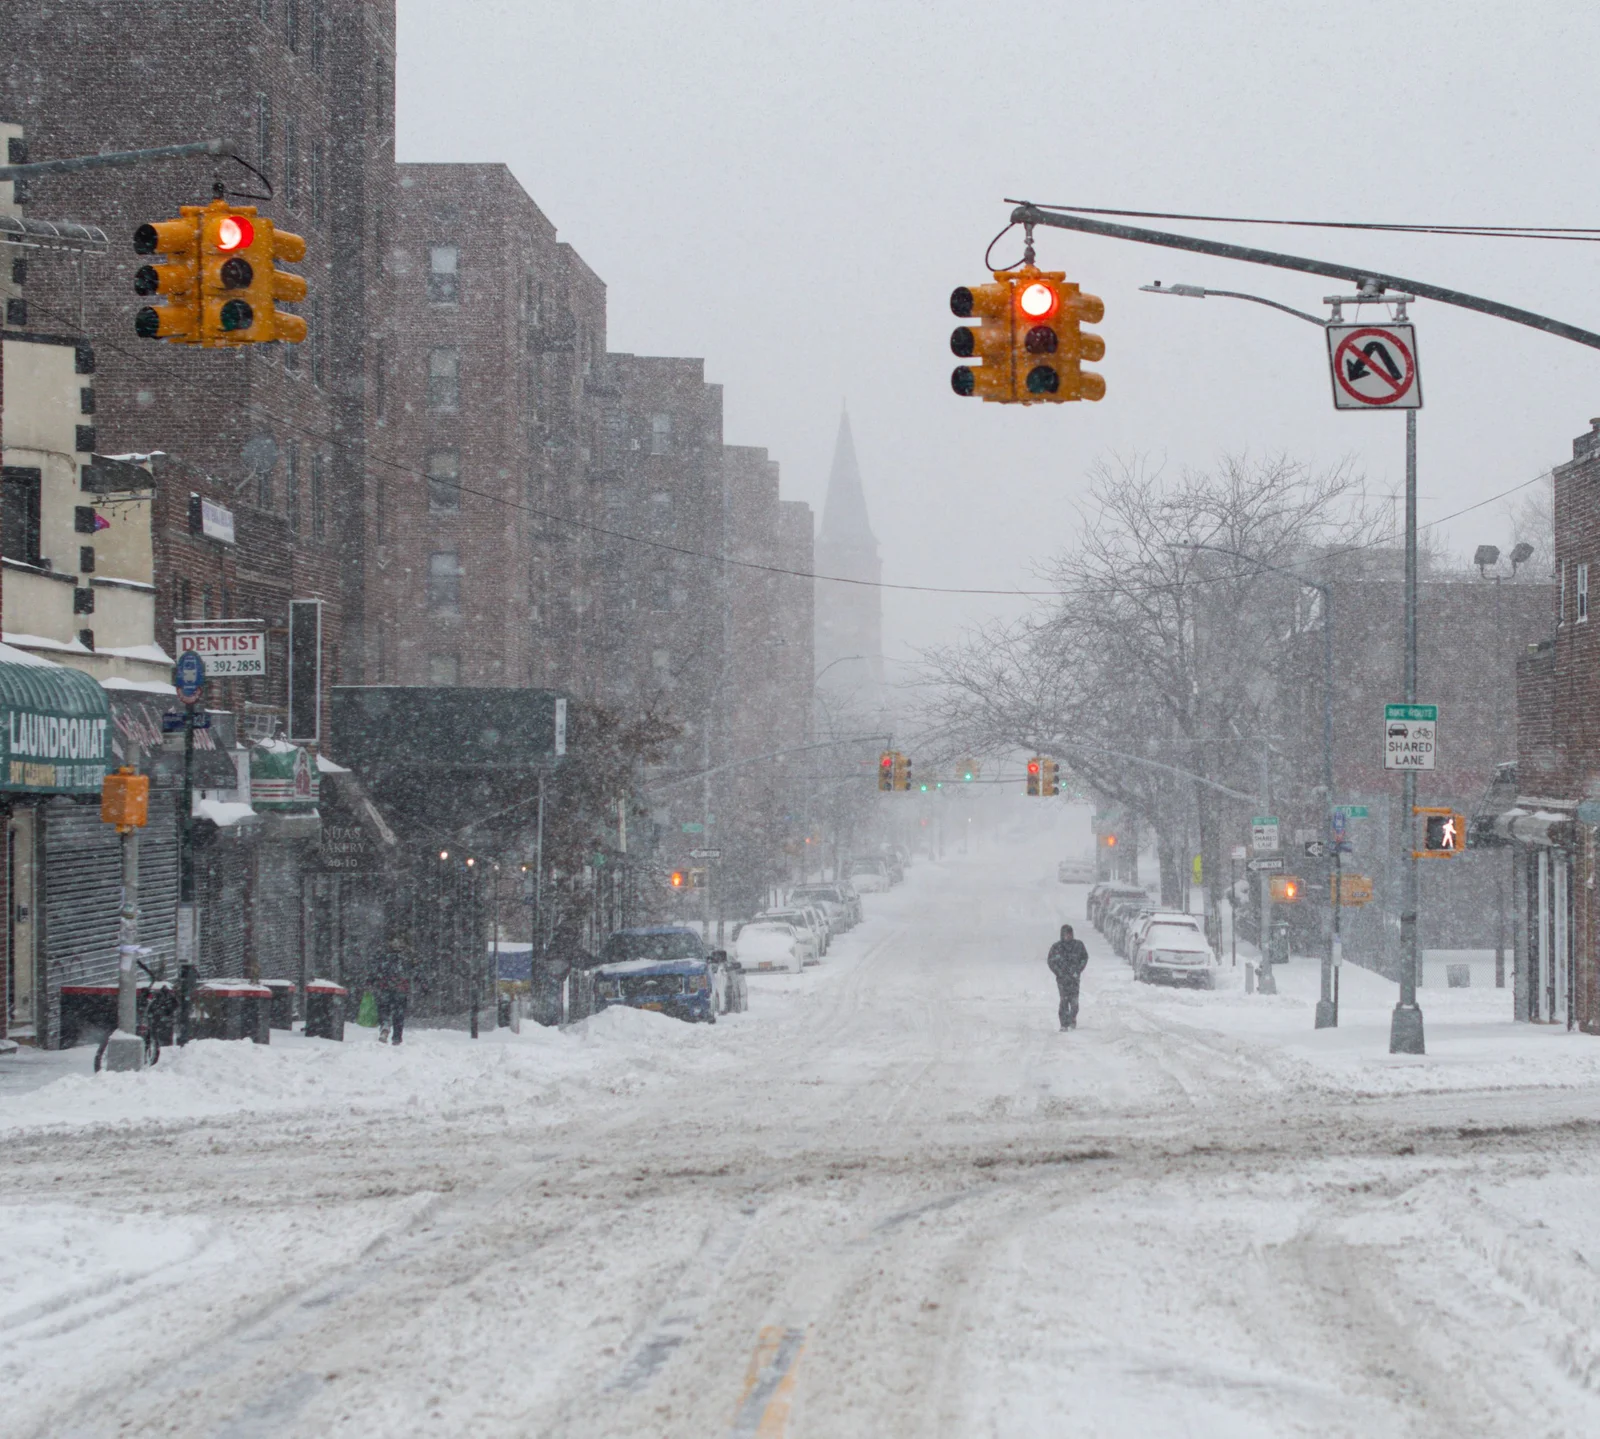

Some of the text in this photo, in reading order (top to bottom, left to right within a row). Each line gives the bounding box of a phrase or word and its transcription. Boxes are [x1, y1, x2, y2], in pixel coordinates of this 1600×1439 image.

[181, 635, 259, 651] DENTIST
[213, 660, 261, 672] 392-2858
[1388, 708, 1433, 718] BIKE ROUTE
[10, 711, 107, 759] LAUNDROMAT
[1388, 741, 1433, 752] SHARED
[1395, 755, 1424, 765] LANE
[317, 843, 366, 853] BAKERY
[328, 859, 358, 867] 40-10
